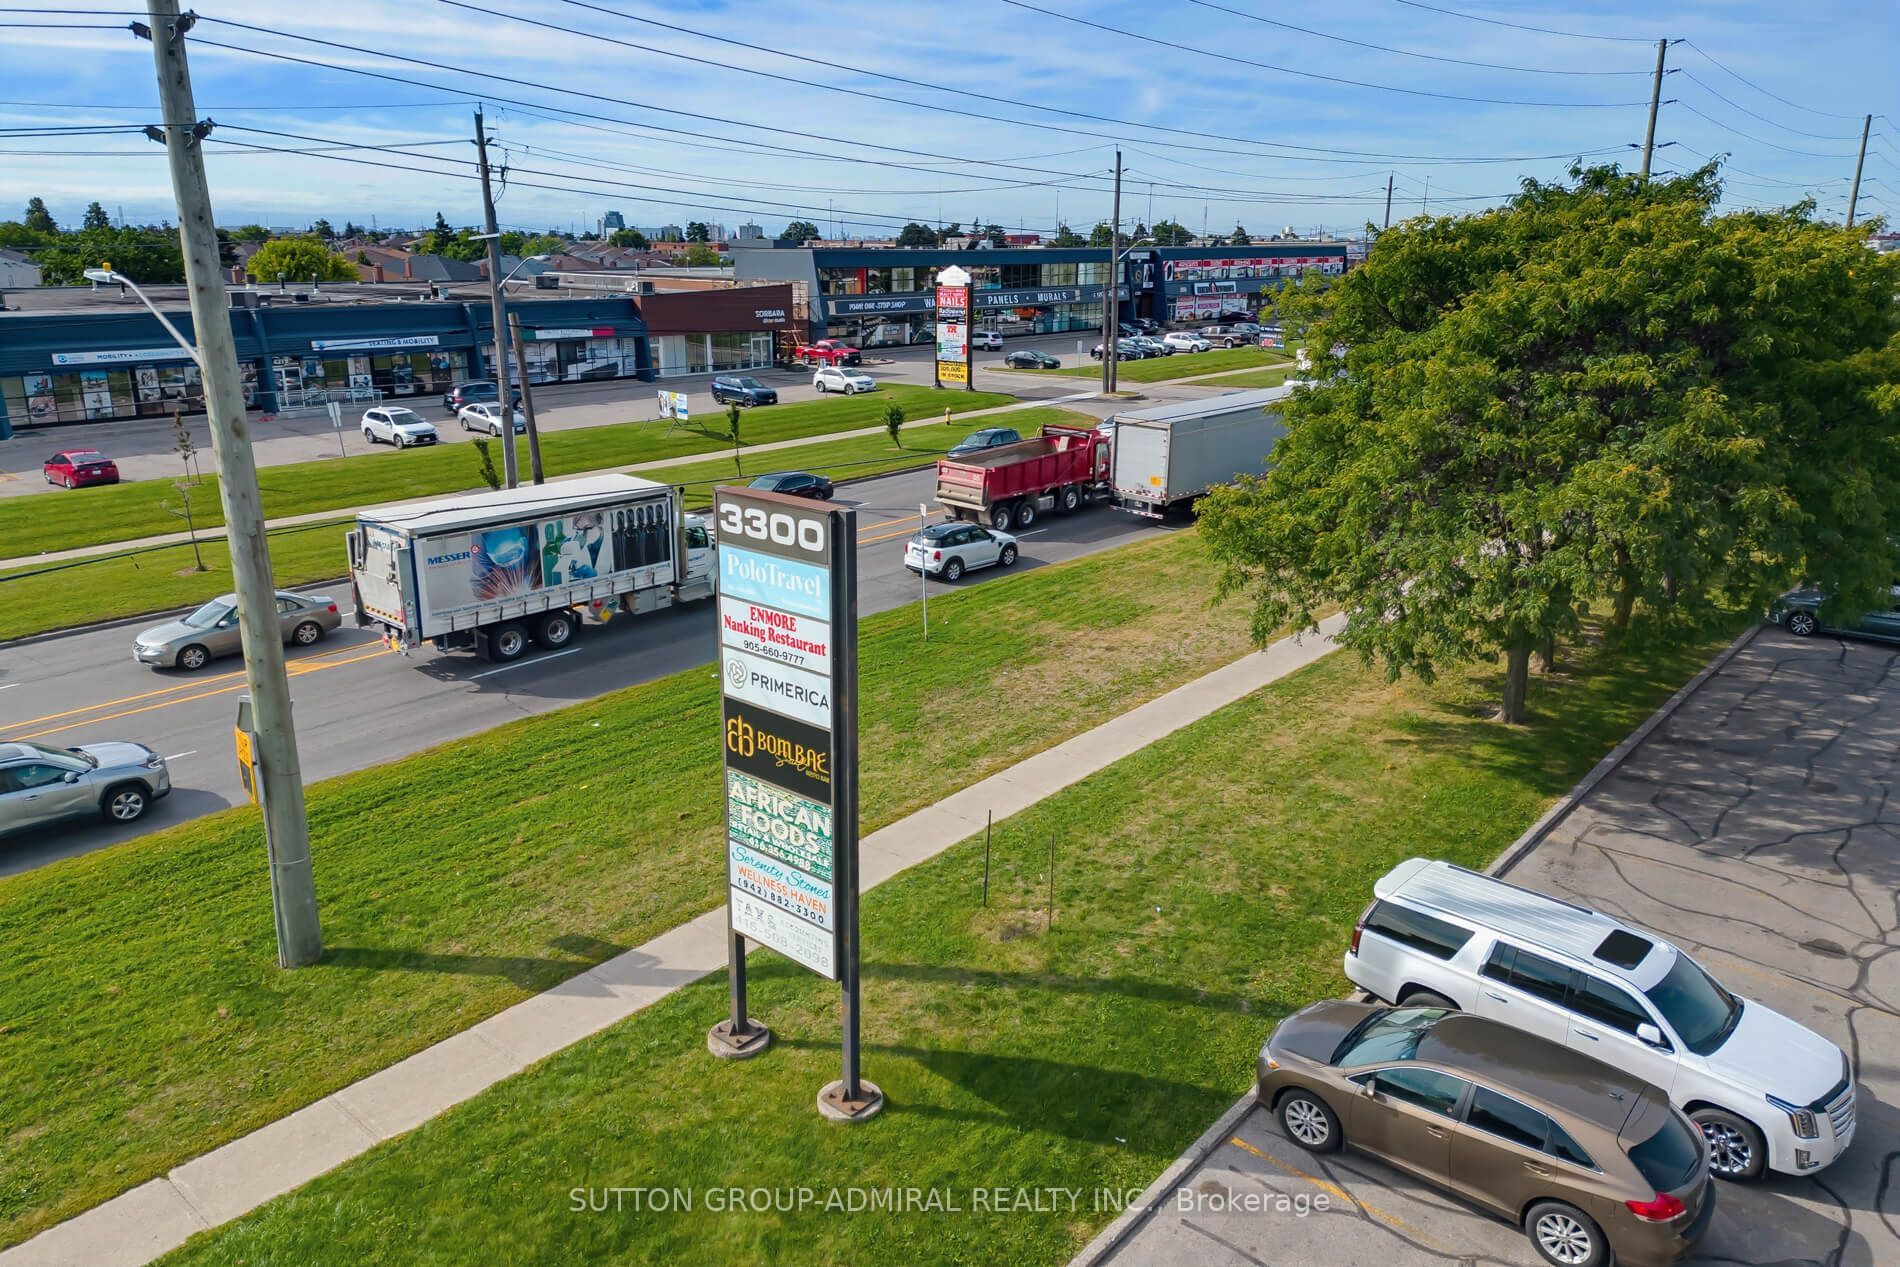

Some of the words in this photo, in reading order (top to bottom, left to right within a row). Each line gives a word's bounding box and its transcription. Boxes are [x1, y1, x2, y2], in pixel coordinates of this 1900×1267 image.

[939, 296, 965, 306] NAILS
[987, 294, 1019, 305] PANELS
[1037, 291, 1067, 302] MURALS
[720, 503, 824, 552] 3300
[427, 551, 471, 566] MESSER
[723, 614, 766, 643] Nanking
[768, 627, 826, 656] Restaurant
[750, 606, 797, 633] ENMORE
[743, 640, 805, 665] 905-660-9777
[751, 671, 829, 710] PRIMERICA
[729, 780, 832, 838] AFRICAN
[741, 804, 820, 854] FOODS
[737, 863, 788, 897] WELLNESS
[790, 888, 827, 914] HAVEN
[786, 869, 831, 900] Stones
